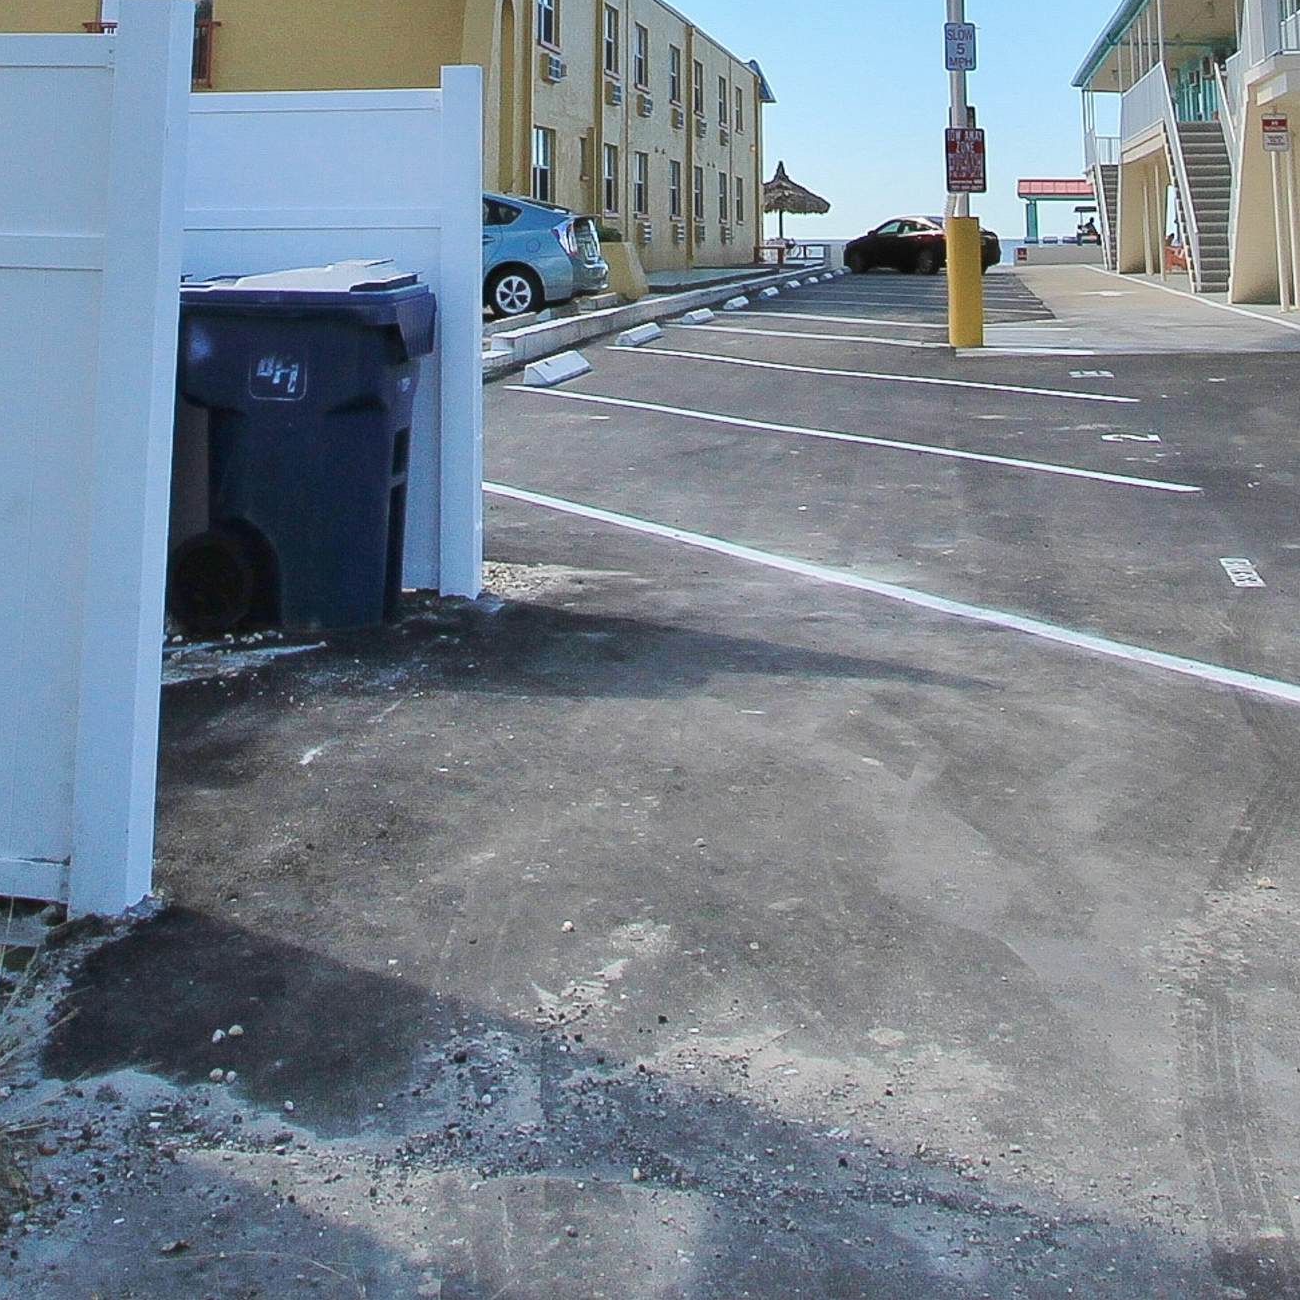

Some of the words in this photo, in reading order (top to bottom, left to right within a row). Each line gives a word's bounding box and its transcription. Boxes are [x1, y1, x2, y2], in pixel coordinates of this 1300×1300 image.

[947, 29, 973, 41] SLOW
[956, 42, 966, 56] 5
[949, 56, 973, 68] MPH
